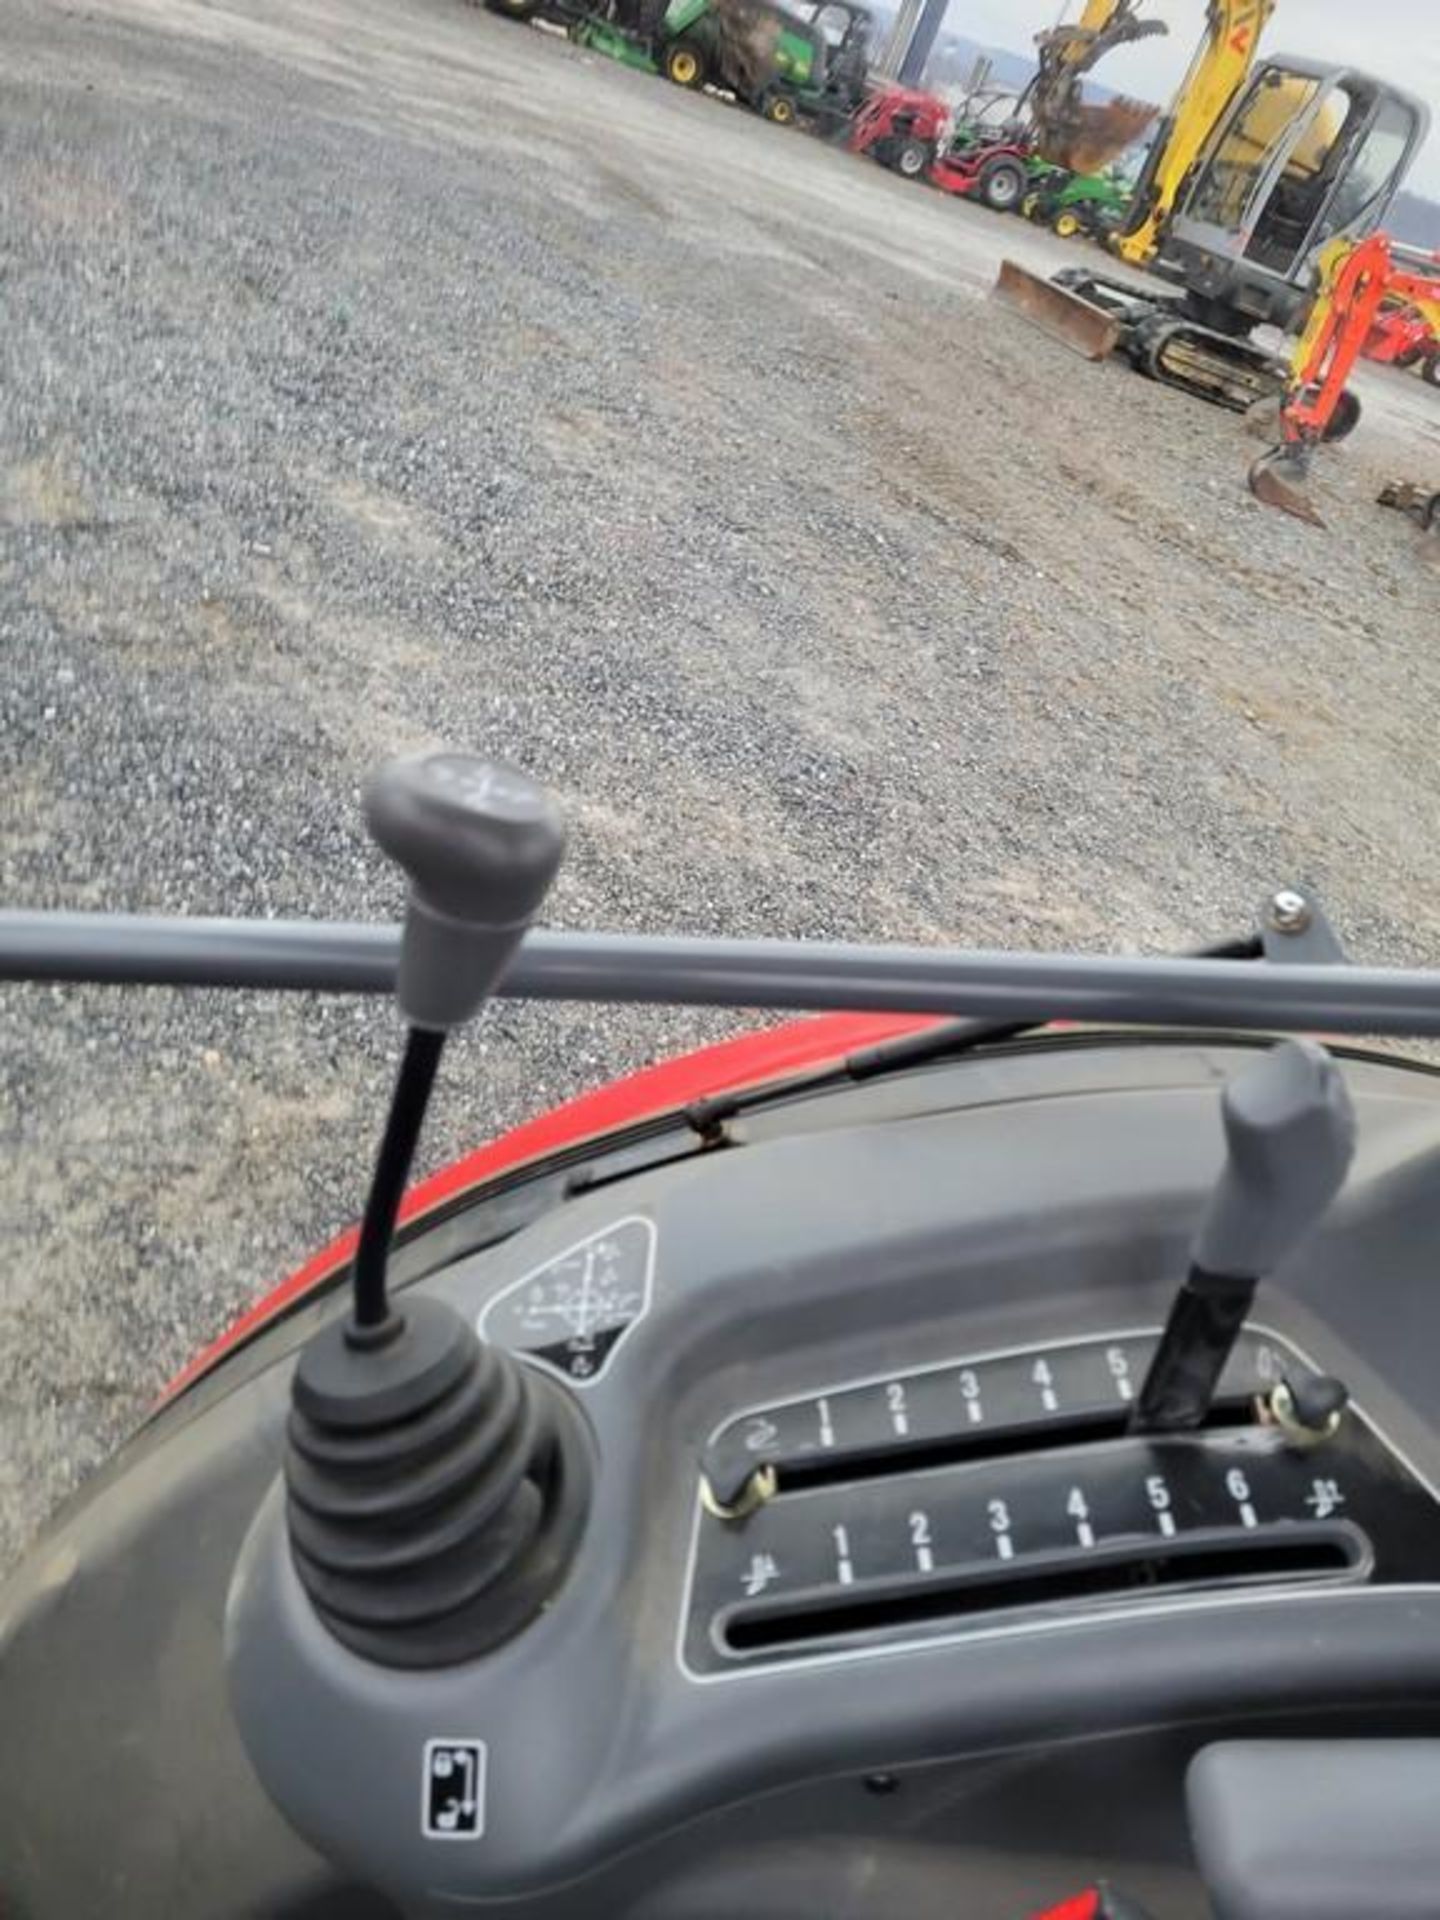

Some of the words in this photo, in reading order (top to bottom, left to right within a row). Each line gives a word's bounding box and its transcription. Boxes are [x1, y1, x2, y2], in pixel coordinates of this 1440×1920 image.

[816, 1398, 830, 1428] 1
[887, 1383, 905, 1411] 2
[960, 1370, 980, 1398] 3
[1032, 1359, 1051, 1384] 4
[1106, 1348, 1128, 1375] 5
[833, 1524, 848, 1557] 1
[908, 1511, 931, 1545] 2
[987, 1499, 1010, 1532] 3
[1067, 1488, 1087, 1518] 4
[1146, 1475, 1171, 1509] 5
[1226, 1468, 1249, 1500] 6
